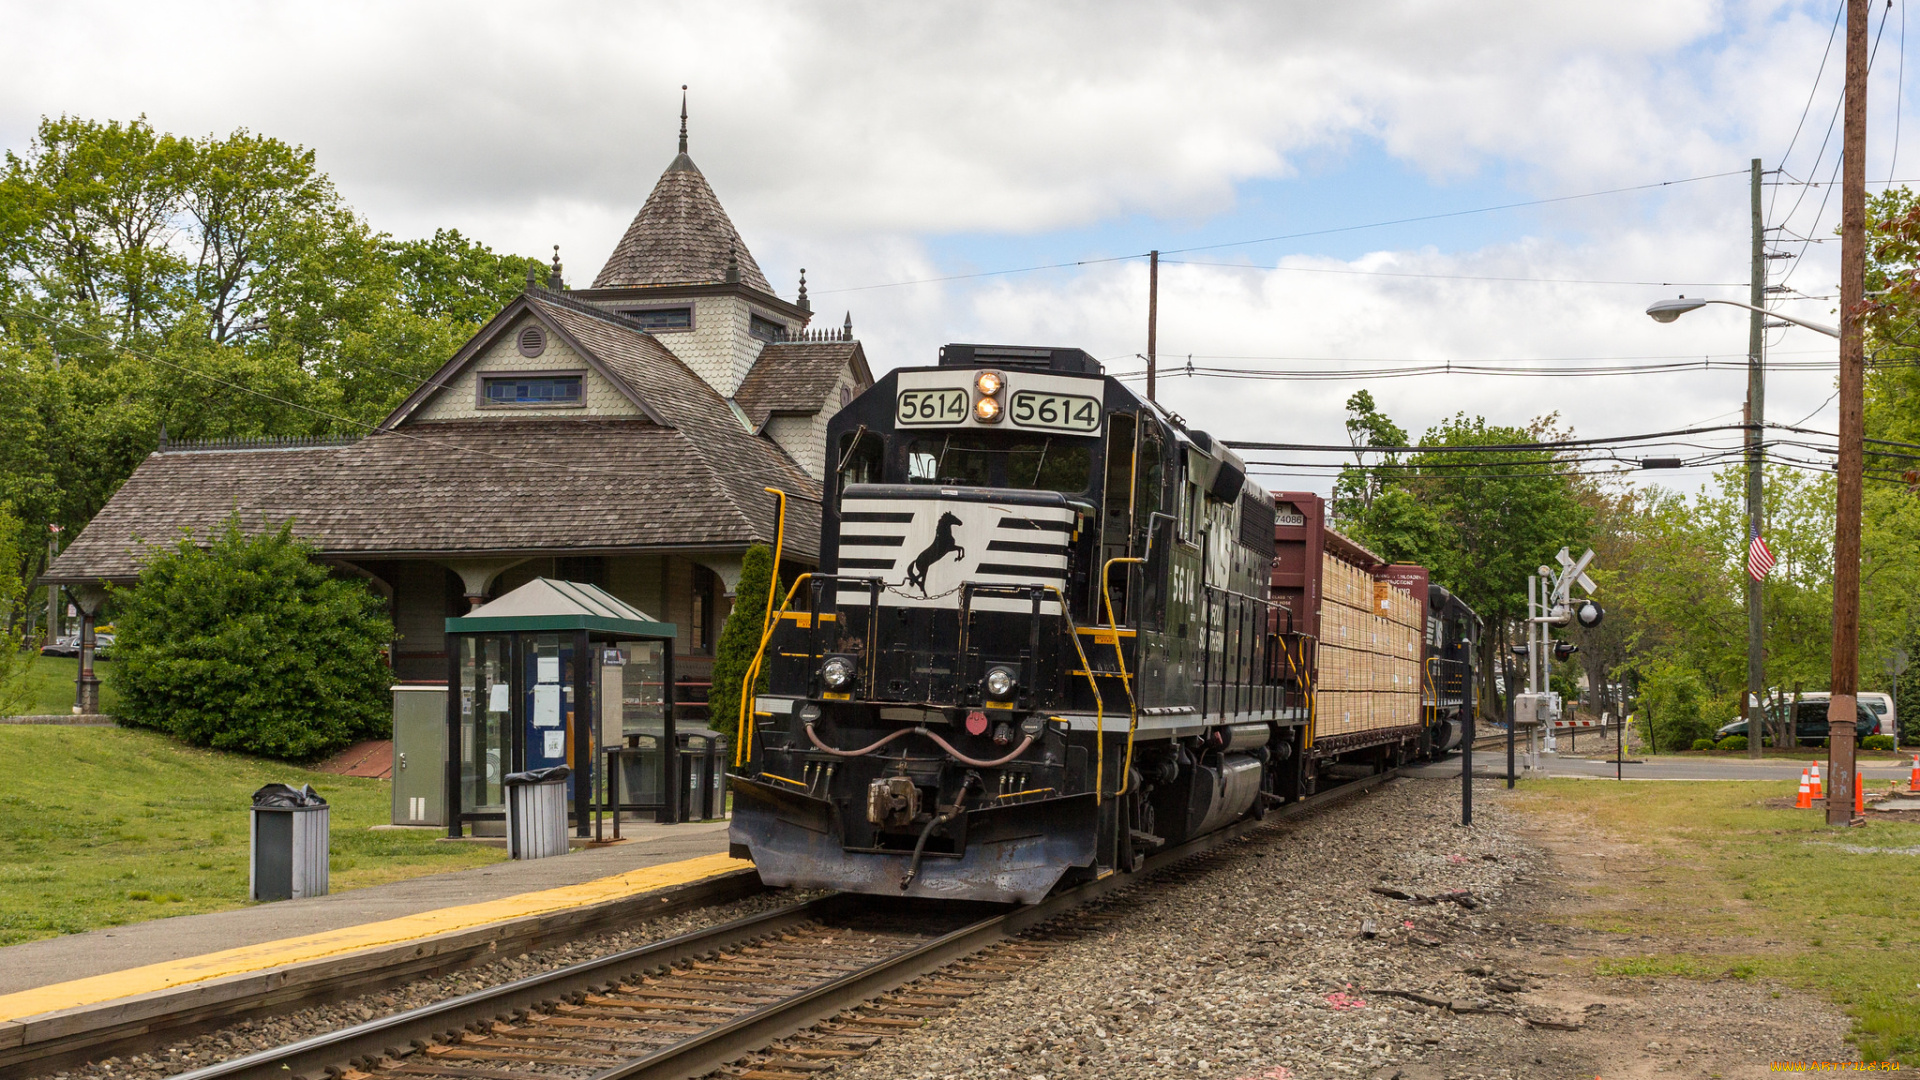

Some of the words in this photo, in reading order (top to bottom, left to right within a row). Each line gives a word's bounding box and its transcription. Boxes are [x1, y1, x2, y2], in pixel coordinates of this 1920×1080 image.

[902, 393, 964, 419] 5614
[1015, 395, 1095, 427] 5614
[1275, 515, 1302, 523] 74086
[1172, 564, 1195, 606] 5614
